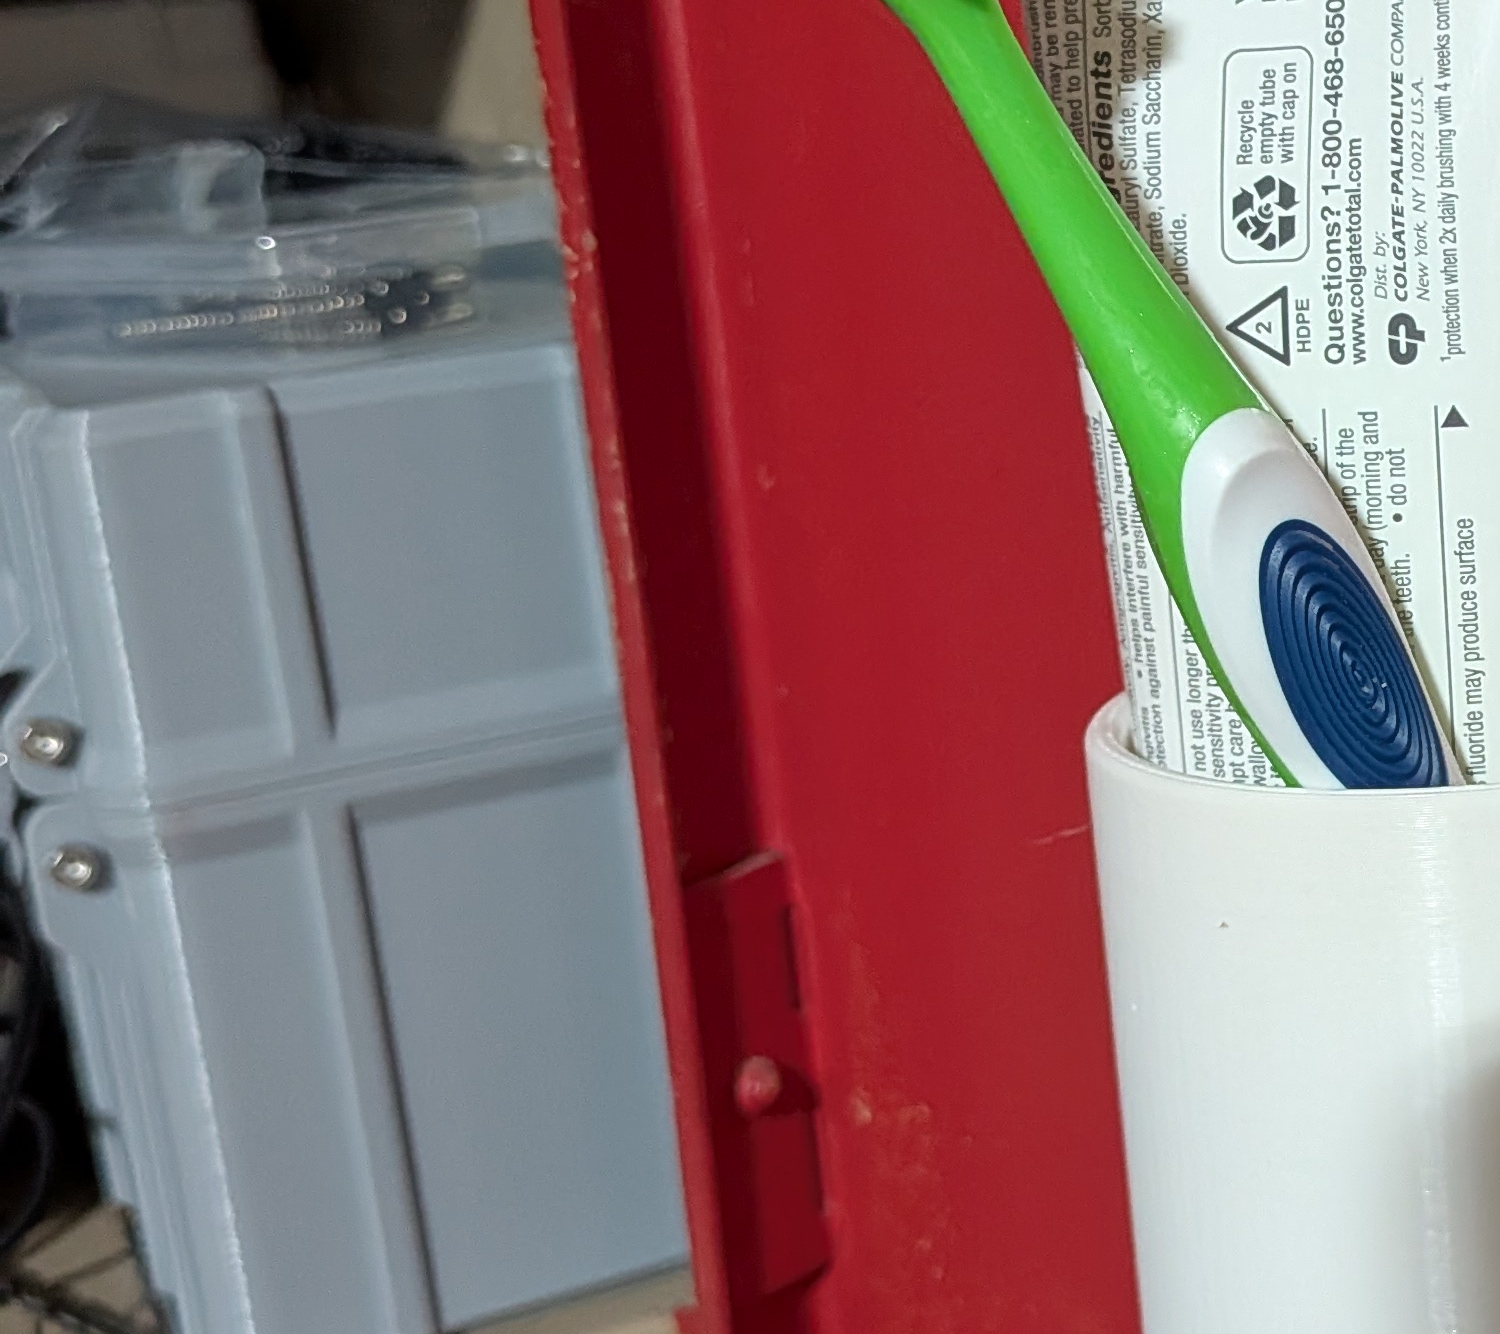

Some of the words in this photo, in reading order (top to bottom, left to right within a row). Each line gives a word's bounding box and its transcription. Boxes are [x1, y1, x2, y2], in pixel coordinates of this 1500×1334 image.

[1046, 34, 1059, 57] be
[1062, 31, 1084, 69] help
[1434, 33, 1453, 79] weeks
[1067, 76, 1082, 92] to
[1140, 29, 1164, 125] Saccharin,
[1258, 69, 1276, 107] tube
[1283, 62, 1297, 84] on
[1434, 82, 1452, 91] 4
[1282, 89, 1298, 121] cap
[1411, 77, 1425, 125] U.S.A.
[1434, 96, 1453, 124] with
[1116, 101, 1138, 170] Sulfate,
[1237, 100, 1259, 165] Recycle
[1259, 114, 1278, 165] empty
[1279, 128, 1295, 164] with
[1142, 131, 1162, 200] Sodium
[1411, 131, 1425, 182] 10022
[1436, 128, 1458, 188] brushing
[1390, 71, 1408, 302] COLGATE-PALMOLIVE
[1413, 188, 1427, 213] NY
[1438, 192, 1460, 224] daily
[1345, 137, 1367, 365] www.colgatetotal.com
[1372, 231, 1390, 257] by:
[1414, 220, 1430, 257] York,
[1440, 227, 1458, 244] 2x
[1320, 205, 1346, 365] Questions?
[1373, 263, 1388, 299] Dist.
[1415, 263, 1430, 302] New
[1441, 248, 1459, 284] when
[1255, 321, 1273, 334] 2
[1296, 298, 1312, 353] HDPE
[1334, 428, 1354, 457] the
[1357, 411, 1380, 445] and
[1105, 428, 1125, 495] harmful
[1337, 462, 1351, 479] of
[1385, 448, 1405, 478] not
[1361, 451, 1388, 531] (morning
[1387, 484, 1407, 506] do
[1113, 501, 1130, 537] with
[1453, 518, 1476, 585] surface
[1120, 543, 1140, 613] interfere
[1390, 553, 1412, 604] teeth.
[1135, 574, 1157, 633] painful
[1128, 618, 1145, 663] helps
[1458, 589, 1480, 662] produce
[1143, 637, 1162, 699] against
[1185, 649, 1203, 703] longer
[1463, 668, 1484, 705] may
[1190, 709, 1204, 739] use
[1205, 693, 1226, 777] sensitivity
[1231, 719, 1244, 757] care
[1463, 710, 1486, 776] fluoride
[1191, 745, 1207, 772] not
[1247, 740, 1266, 786] wallo
